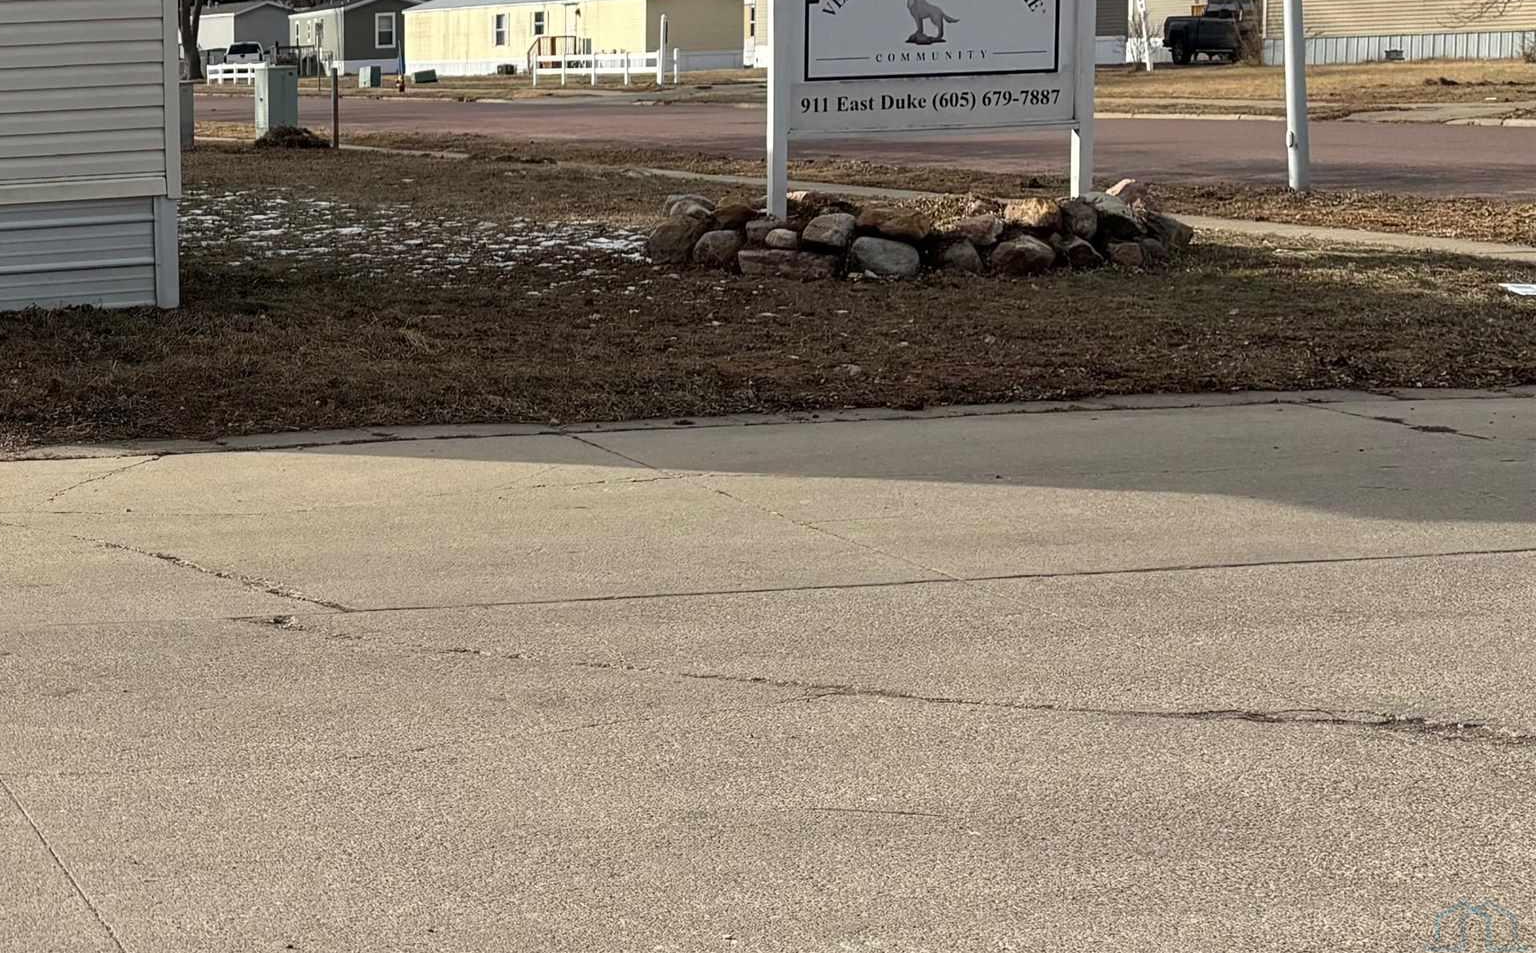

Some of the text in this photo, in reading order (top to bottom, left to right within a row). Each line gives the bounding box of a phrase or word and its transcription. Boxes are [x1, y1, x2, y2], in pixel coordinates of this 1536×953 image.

[875, 49, 989, 63] COMMUNITY
[801, 89, 1061, 114] 911 East Duke (605) 679-7887
